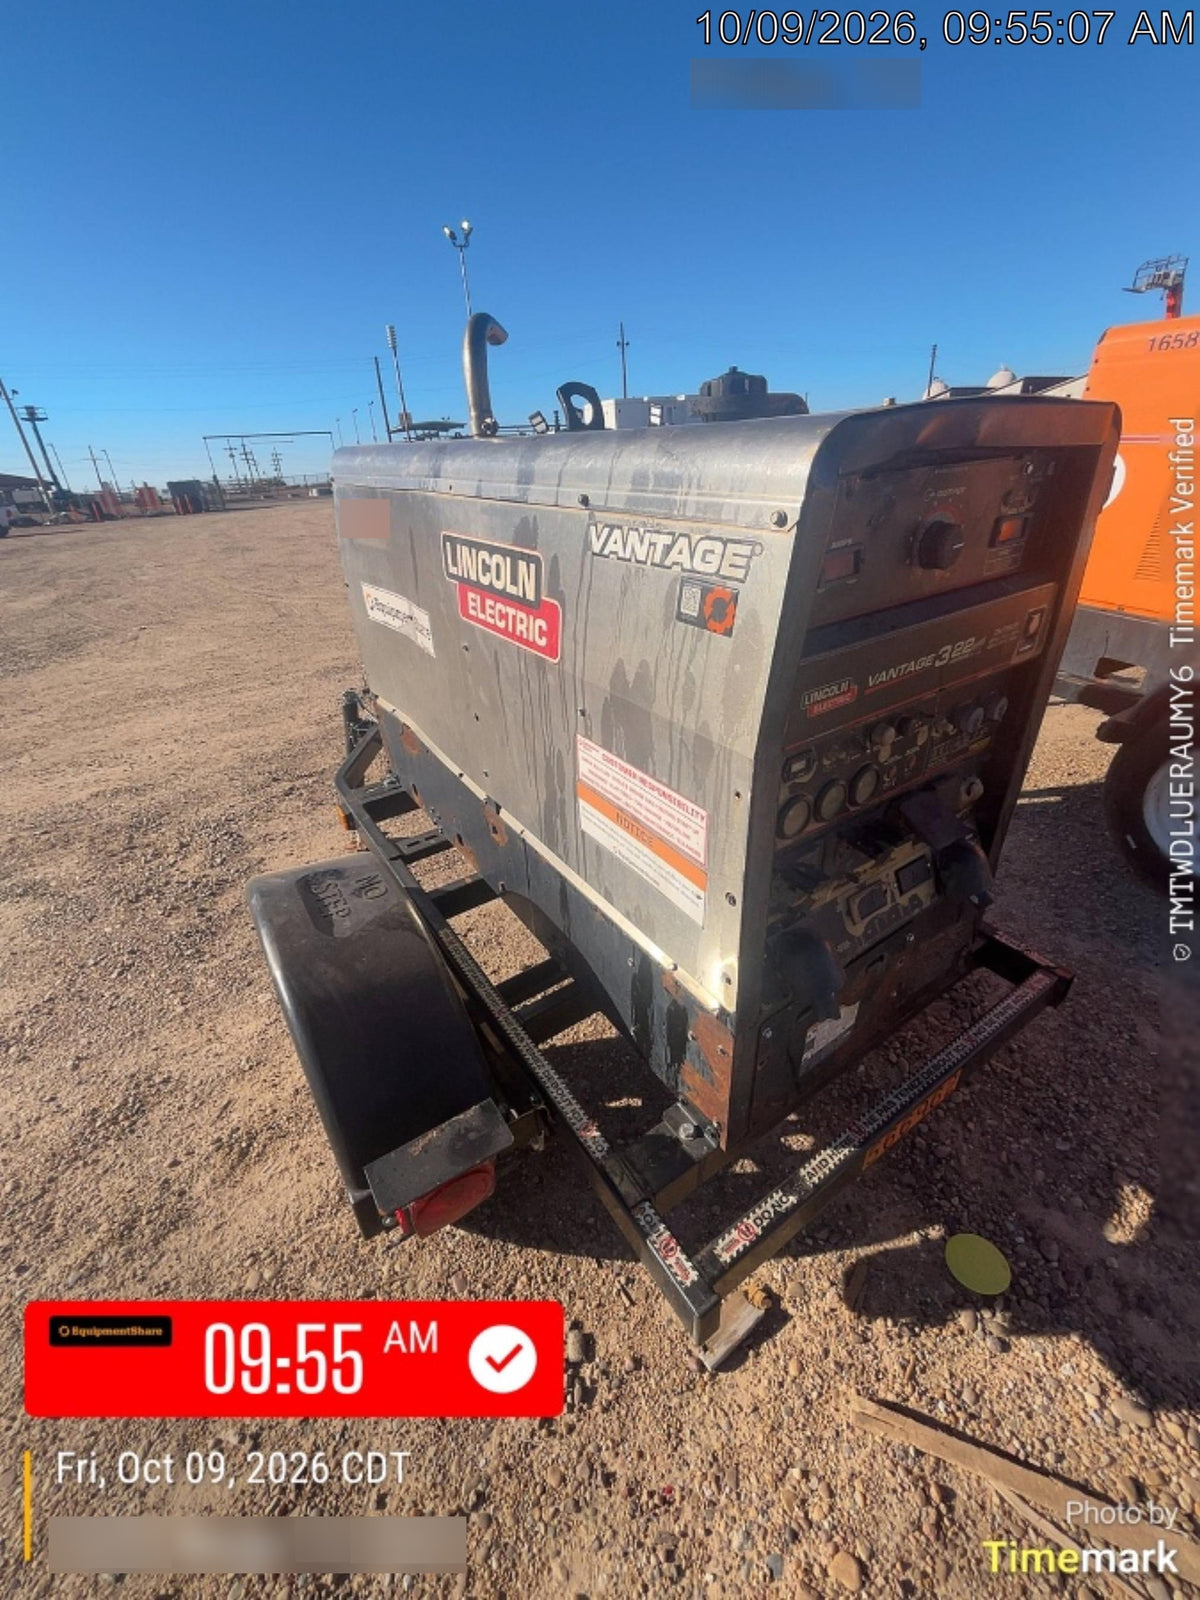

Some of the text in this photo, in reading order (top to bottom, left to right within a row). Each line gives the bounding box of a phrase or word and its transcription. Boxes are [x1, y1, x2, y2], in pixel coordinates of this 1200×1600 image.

[1148, 330, 1200, 352] 1658
[445, 541, 537, 602] LINCOLN
[589, 523, 757, 583] VANTAGE
[467, 591, 549, 648] ELECTRIC
[803, 679, 851, 706] LINCOLN
[867, 657, 935, 689] VANTAGE
[638, 773, 705, 822] RESPONSIBILITY
[615, 811, 654, 848] NOTICE
[355, 873, 389, 900] NO
[540, 1069, 572, 1108] DEBOUT
[569, 1107, 583, 1123] ICI
[589, 1135, 605, 1153] NO
[751, 1208, 773, 1228] DO
[770, 1190, 793, 1211] NO
[875, 1098, 896, 1117] PAS
